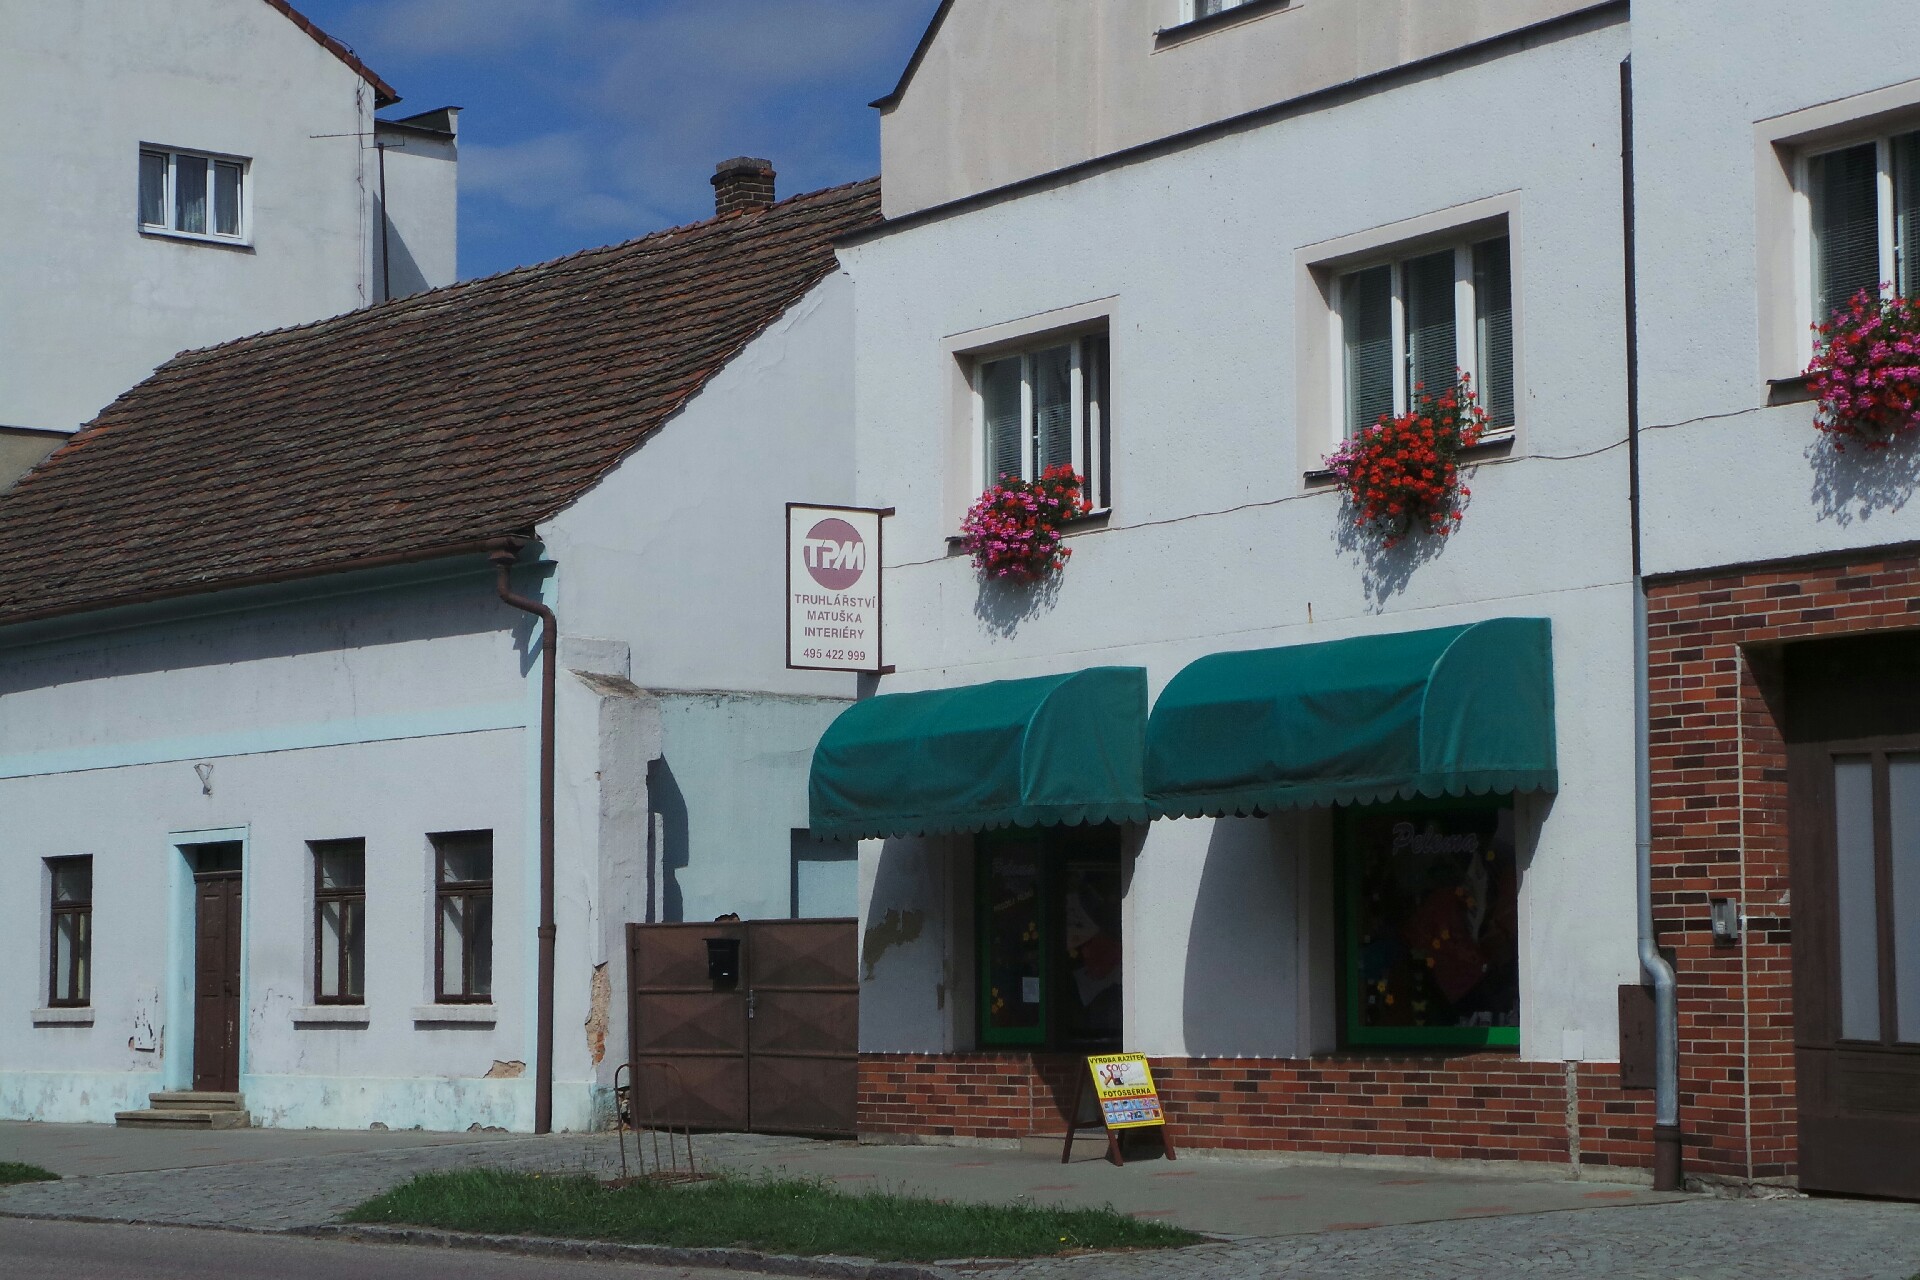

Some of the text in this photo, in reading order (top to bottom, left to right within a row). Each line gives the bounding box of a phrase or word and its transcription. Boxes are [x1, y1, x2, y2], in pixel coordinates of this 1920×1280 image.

[803, 538, 865, 571] TPM
[795, 593, 876, 609] TRUHLÁŘSTVÍ
[807, 610, 862, 623] MATUŠKA
[804, 625, 864, 639] INTERIÉRY
[803, 648, 866, 661] 495 422 999
